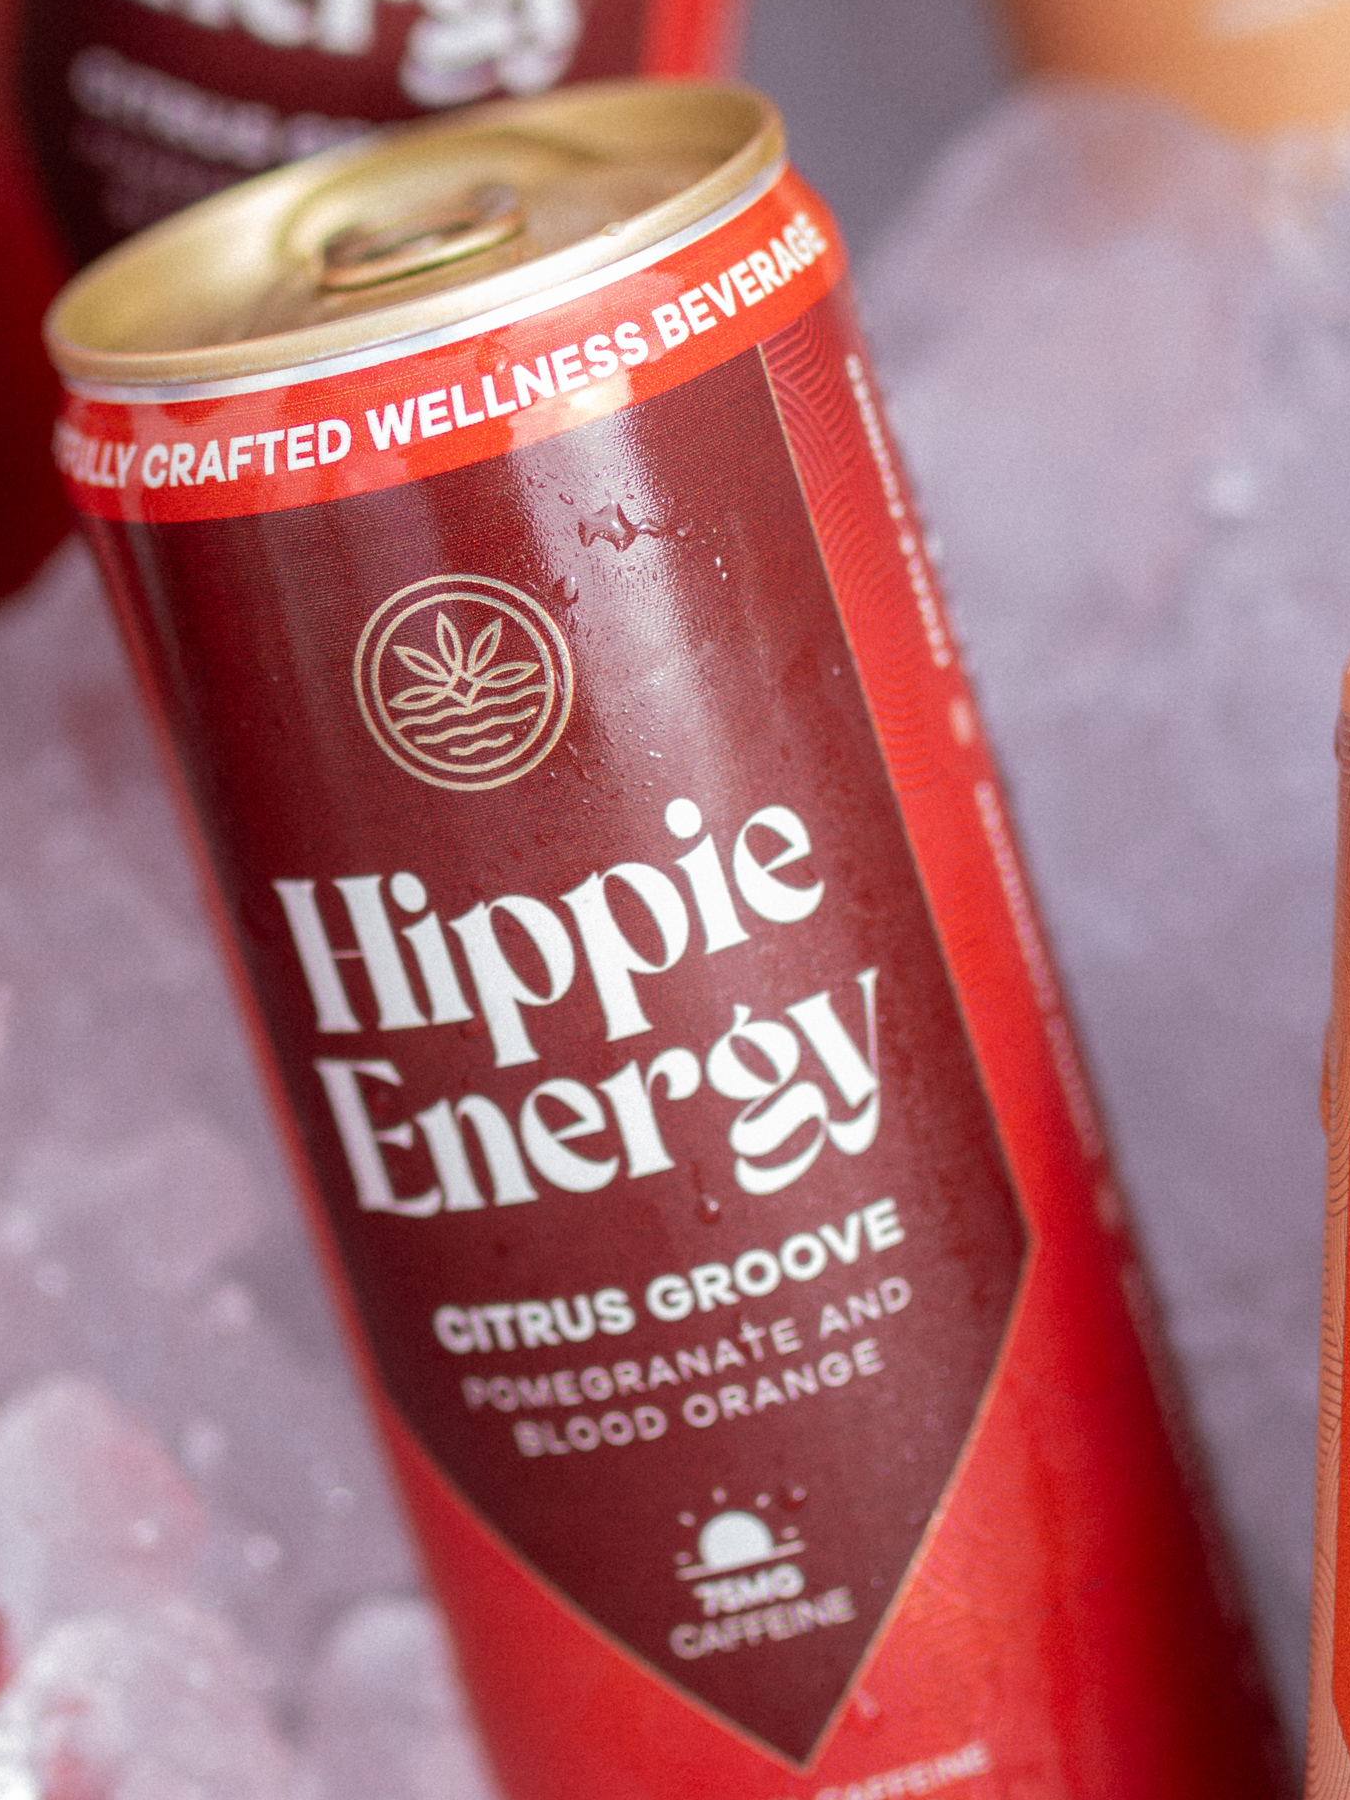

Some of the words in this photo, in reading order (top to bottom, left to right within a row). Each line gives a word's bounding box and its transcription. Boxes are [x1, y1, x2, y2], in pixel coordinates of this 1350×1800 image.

[142, 417, 351, 489] CRAFTED
[364, 320, 651, 451] WELLNESS
[650, 212, 828, 347] BEVERAGE
[272, 797, 825, 1069] Hippie
[312, 965, 881, 1218] Energy
[432, 1286, 637, 1355] CITRUS
[644, 1196, 906, 1322] GROOVE
[460, 1316, 804, 1412] POMEGRANATE
[818, 1275, 913, 1340] AND
[512, 1404, 668, 1459] BLOOD
[681, 1337, 886, 1429] ORANGE
[668, 1585, 857, 1661] CAFFEINE
